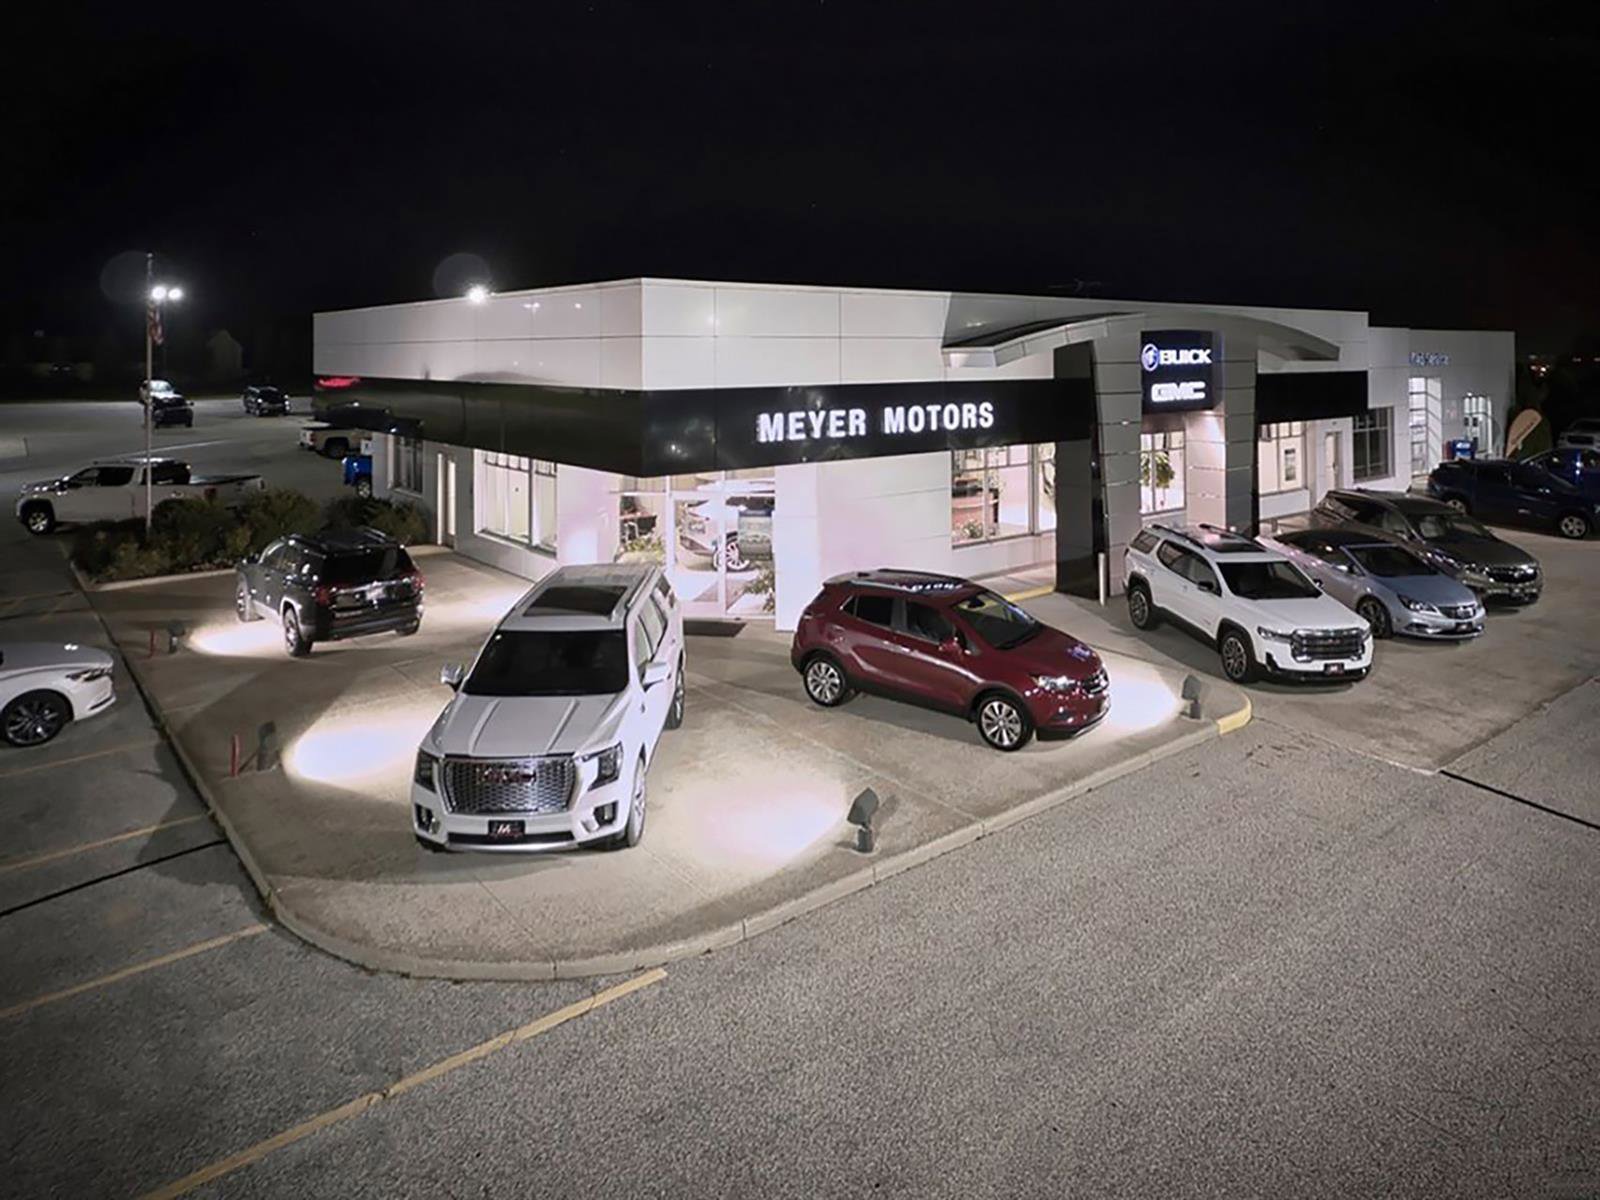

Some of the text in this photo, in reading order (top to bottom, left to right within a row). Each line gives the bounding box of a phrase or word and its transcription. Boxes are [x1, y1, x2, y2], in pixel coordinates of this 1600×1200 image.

[1160, 348, 1212, 365] BUICK
[1151, 381, 1206, 402] GMC
[756, 402, 995, 443] MEYER MOTORS
